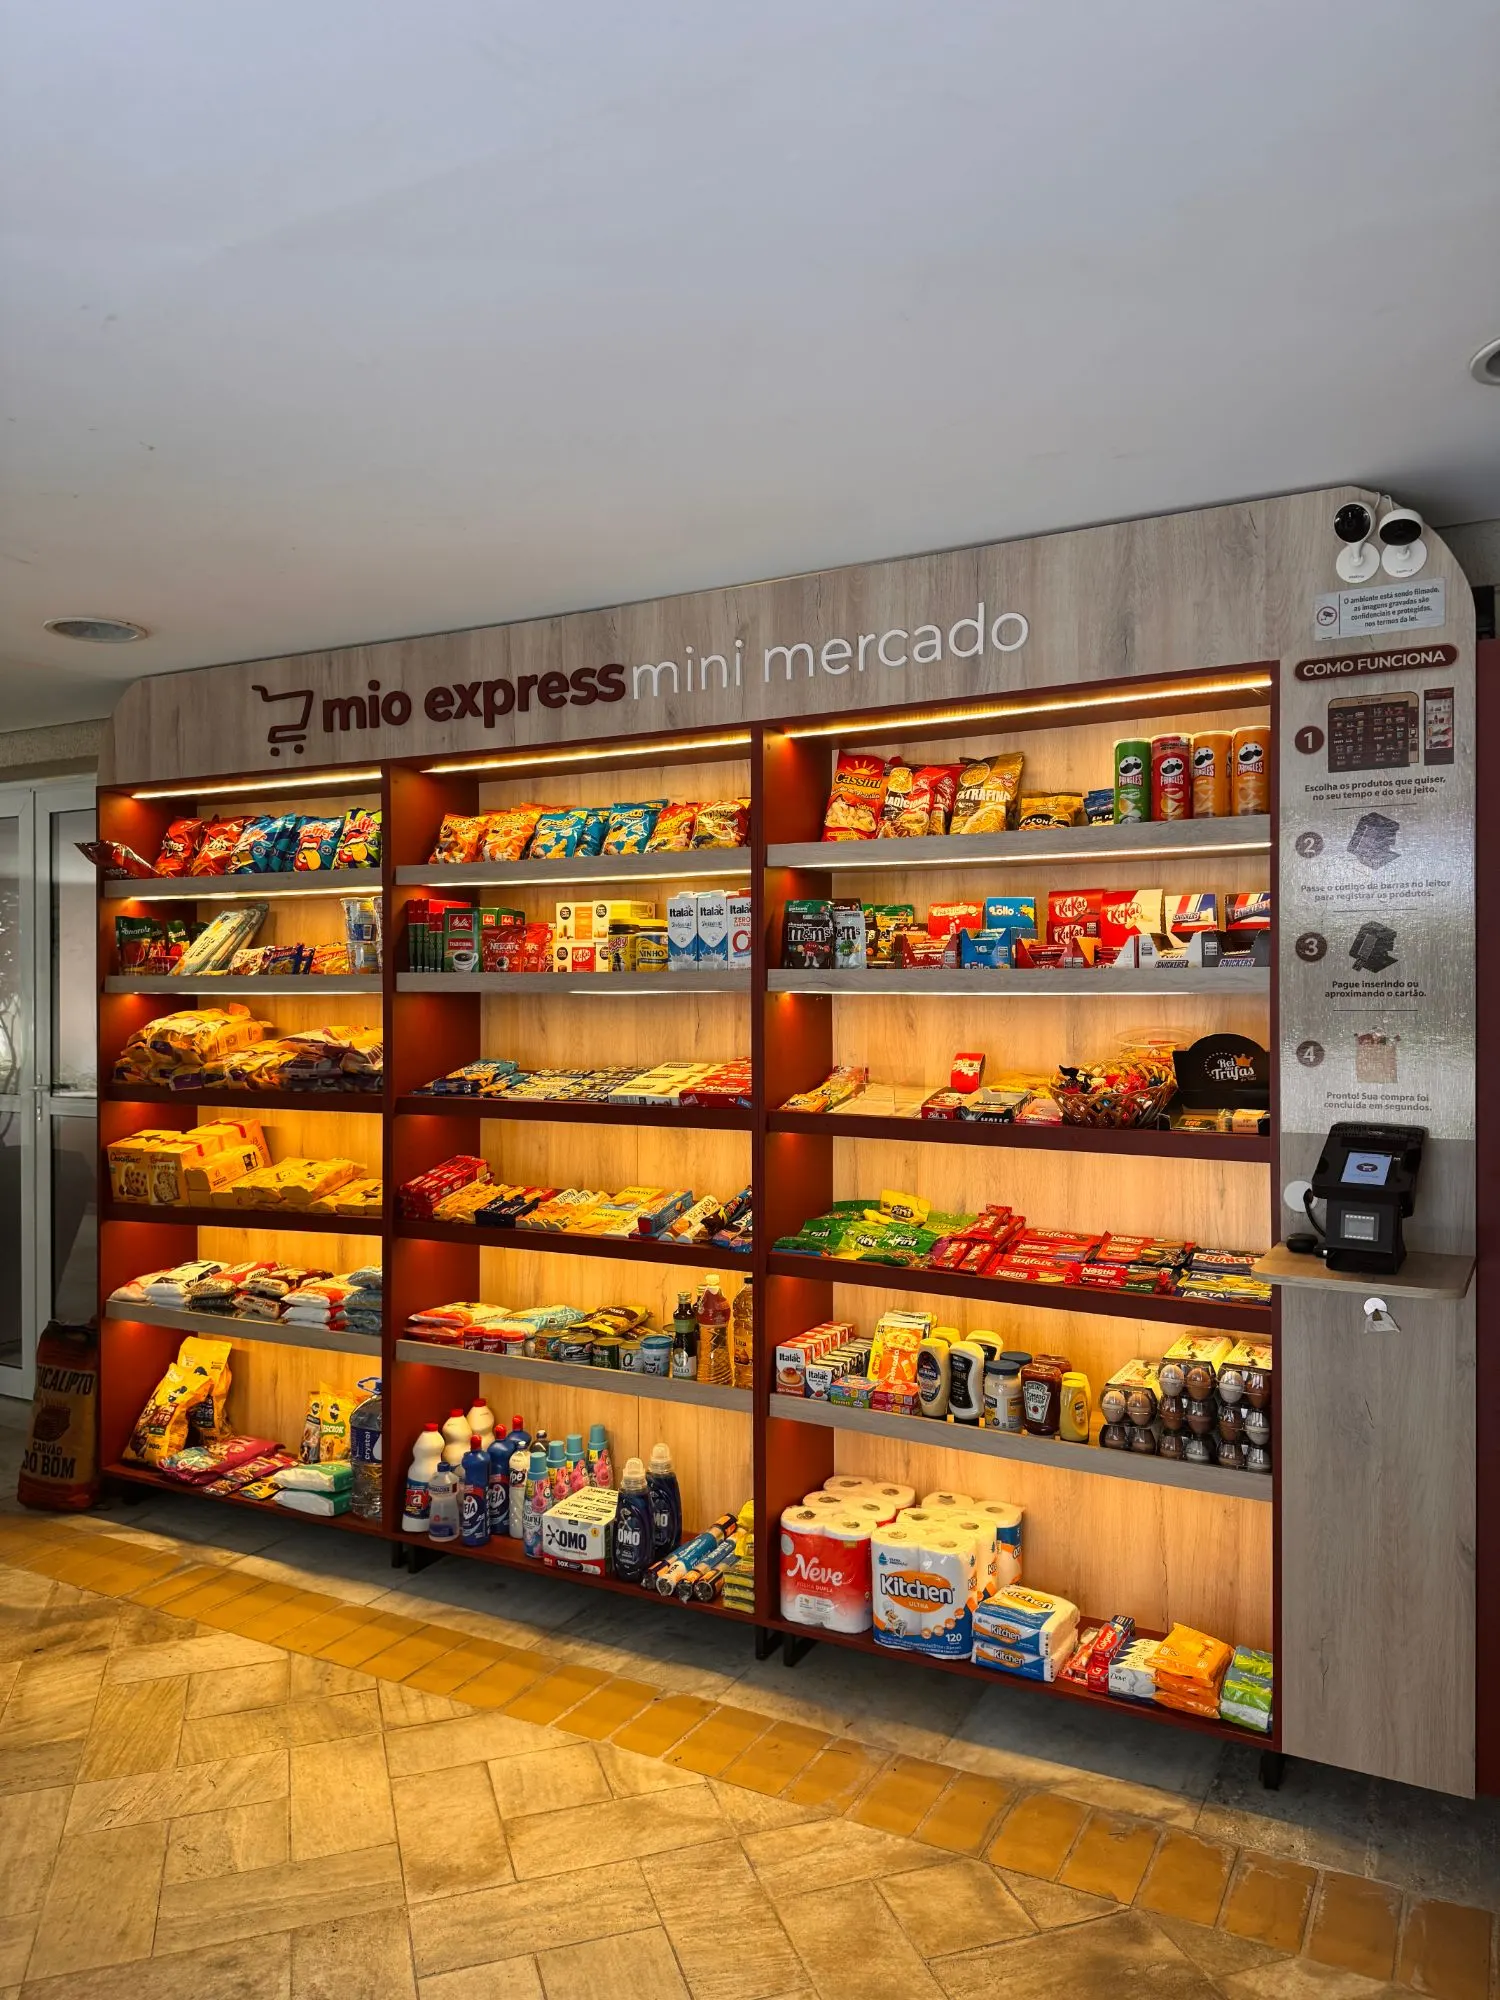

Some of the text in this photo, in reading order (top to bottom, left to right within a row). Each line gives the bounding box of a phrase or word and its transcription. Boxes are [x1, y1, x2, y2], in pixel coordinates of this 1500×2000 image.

[322, 602, 1029, 733] mio express mini mercado
[1303, 650, 1446, 677] COMO FUNCIONA
[1303, 732, 1313, 749] 1
[1238, 762, 1263, 775] PRINGLES
[1119, 774, 1143, 786] PRINGLES
[1160, 774, 1184, 786] PRINGLES
[1305, 783, 1338, 793] Escolha
[1351, 779, 1393, 792] produtos
[1395, 778, 1413, 788] que
[1414, 775, 1446, 786] quiser,
[1326, 792, 1342, 800] seu
[1343, 789, 1372, 800] tempo
[1382, 788, 1394, 796] do
[1396, 788, 1412, 796] seu
[1413, 785, 1438, 796] jeito.
[1303, 837, 1316, 854] 2
[669, 905, 694, 918] Italac
[700, 904, 724, 917] Italac
[1304, 938, 1319, 956] 3
[1219, 958, 1254, 968] SNICKERS
[1332, 980, 1361, 990] Pague
[1361, 980, 1405, 989] inserindo
[1324, 988, 1427, 999] aproximando o cartão.
[1303, 1045, 1316, 1063] 4
[1211, 1067, 1255, 1082] Trufas
[1326, 1091, 1429, 1103] Pronto! Sua compra foi
[1368, 1102, 1383, 1110] em
[1385, 1102, 1433, 1113] segundos.
[779, 1352, 801, 1363] Italac
[808, 1370, 829, 1381] Italac
[40, 1454, 77, 1480] BOM
[653, 1512, 669, 1528] MO
[559, 1530, 587, 1551] OMO
[617, 1529, 641, 1546] OMO
[786, 1553, 844, 1587] Neve
[880, 1573, 954, 1605] Kitchen
[945, 1633, 962, 1642] 120
[990, 1624, 1021, 1642] Kitchen
[993, 1648, 1025, 1665] Kitchen
[1110, 1672, 1127, 1683] Dove
